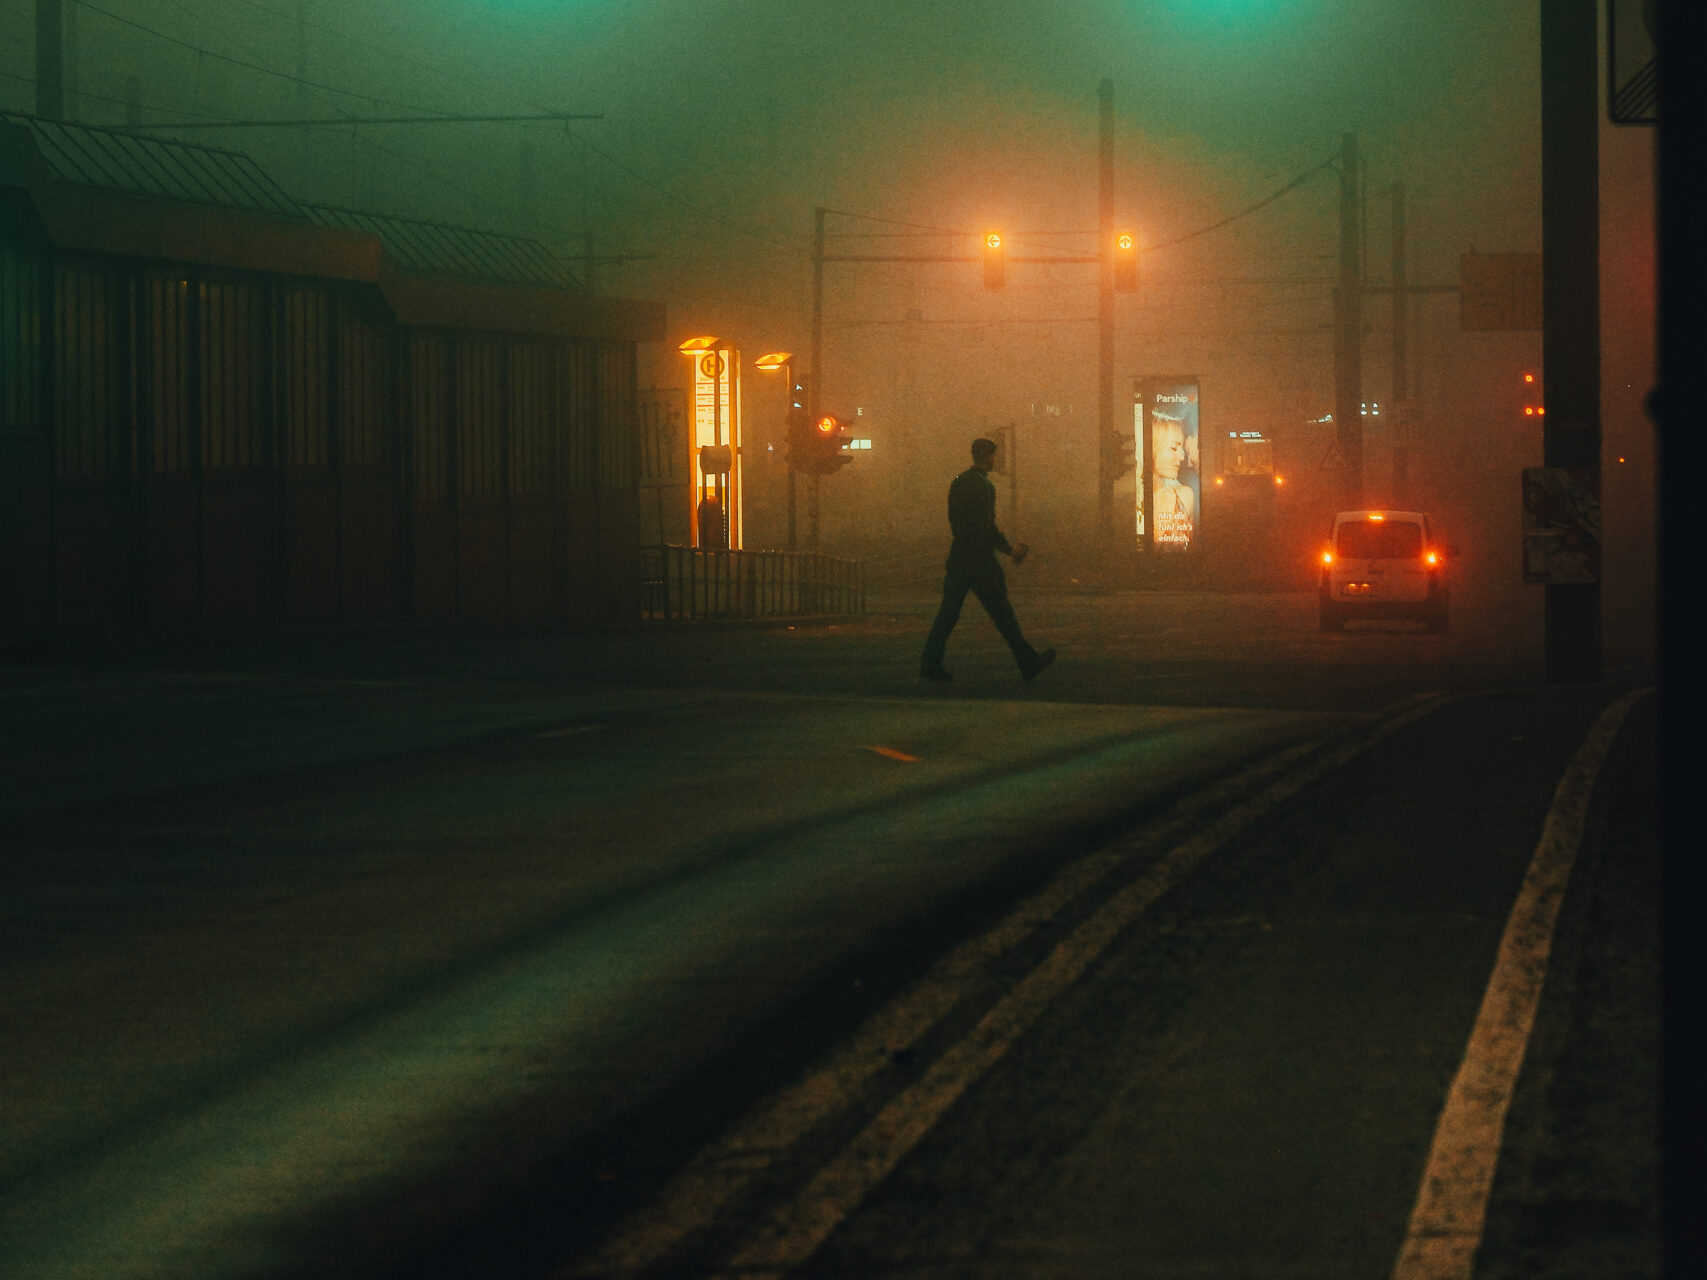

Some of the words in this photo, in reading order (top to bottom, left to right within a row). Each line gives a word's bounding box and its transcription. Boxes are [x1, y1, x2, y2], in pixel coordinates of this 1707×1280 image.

[1156, 393, 1188, 405] Parship
[1158, 512, 1172, 520] Mit
[1174, 512, 1185, 520] dir
